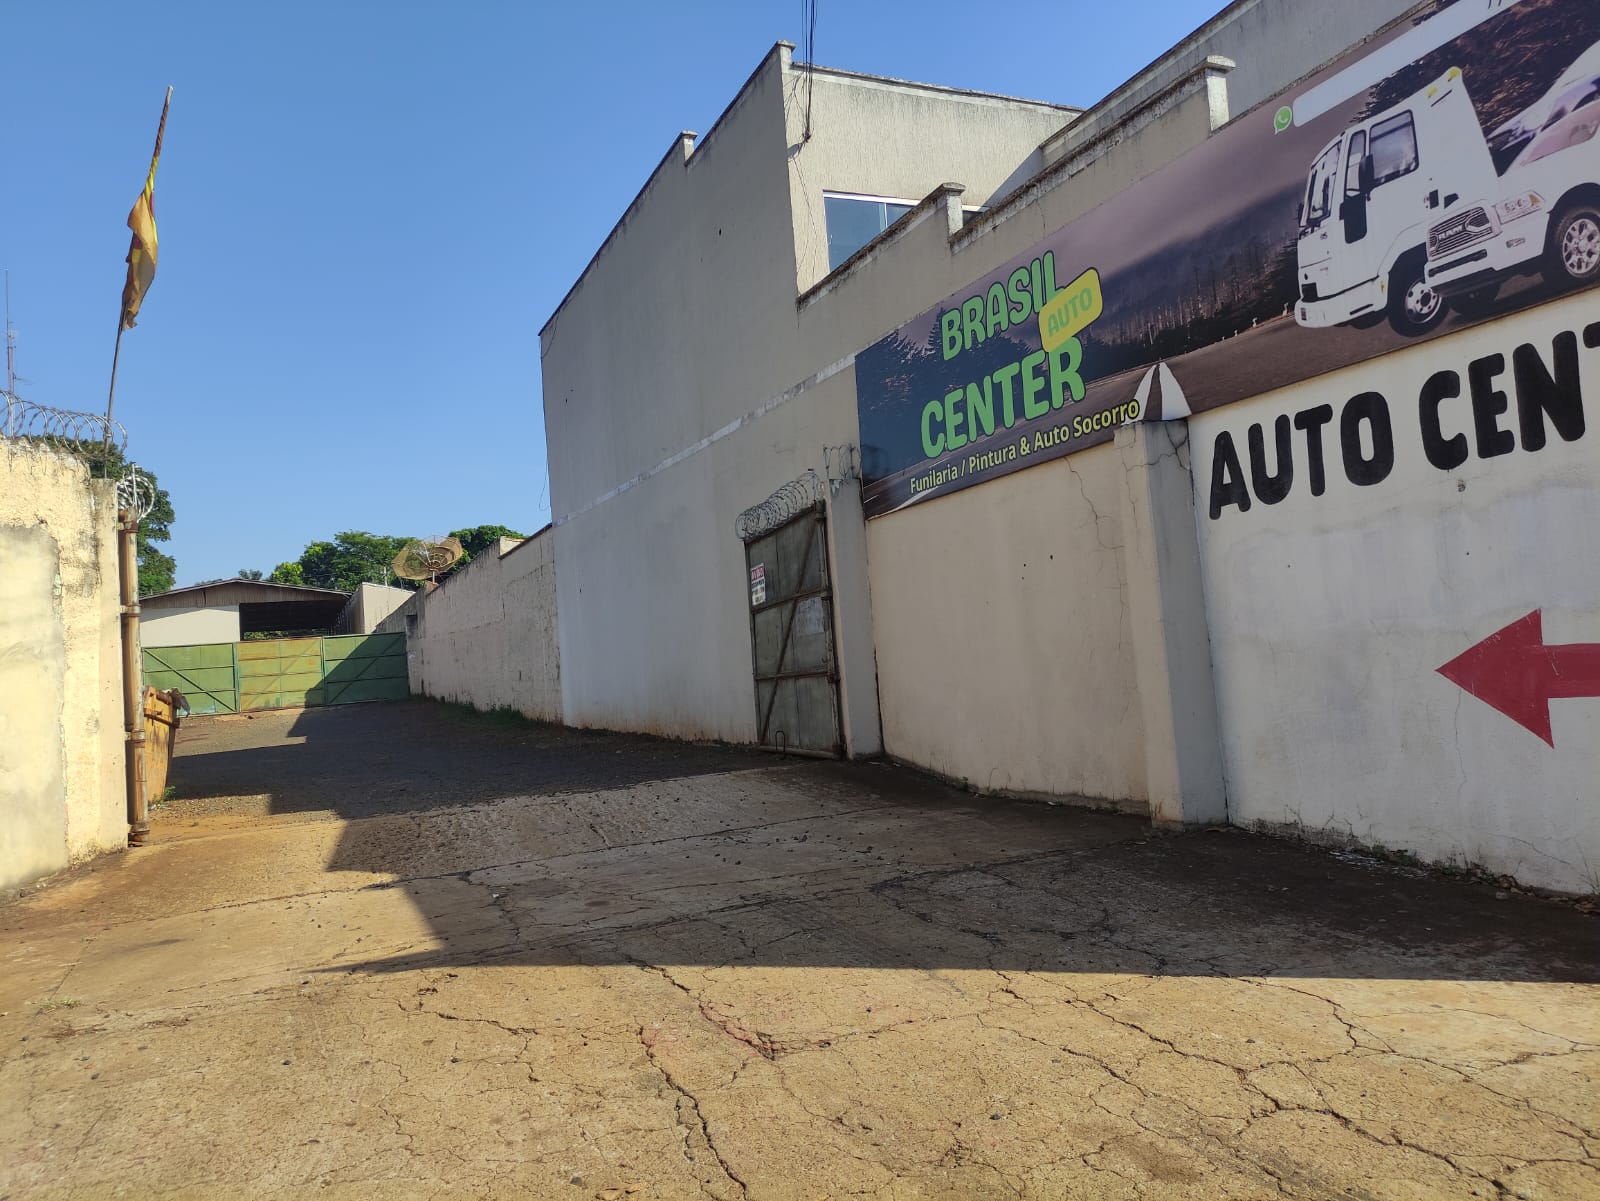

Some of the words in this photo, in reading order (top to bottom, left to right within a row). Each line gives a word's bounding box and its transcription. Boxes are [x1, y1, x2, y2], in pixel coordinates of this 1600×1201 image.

[941, 250, 1066, 361] BRASIL
[1047, 287, 1093, 337] AUTO
[909, 464, 958, 494] Funilaria
[969, 445, 1016, 475] Pintura
[1020, 438, 1031, 455] &
[1034, 424, 1070, 451] Auto
[1073, 399, 1140, 438] Socorro
[921, 336, 1086, 458] CENTER
[1209, 391, 1394, 520] AUTO
